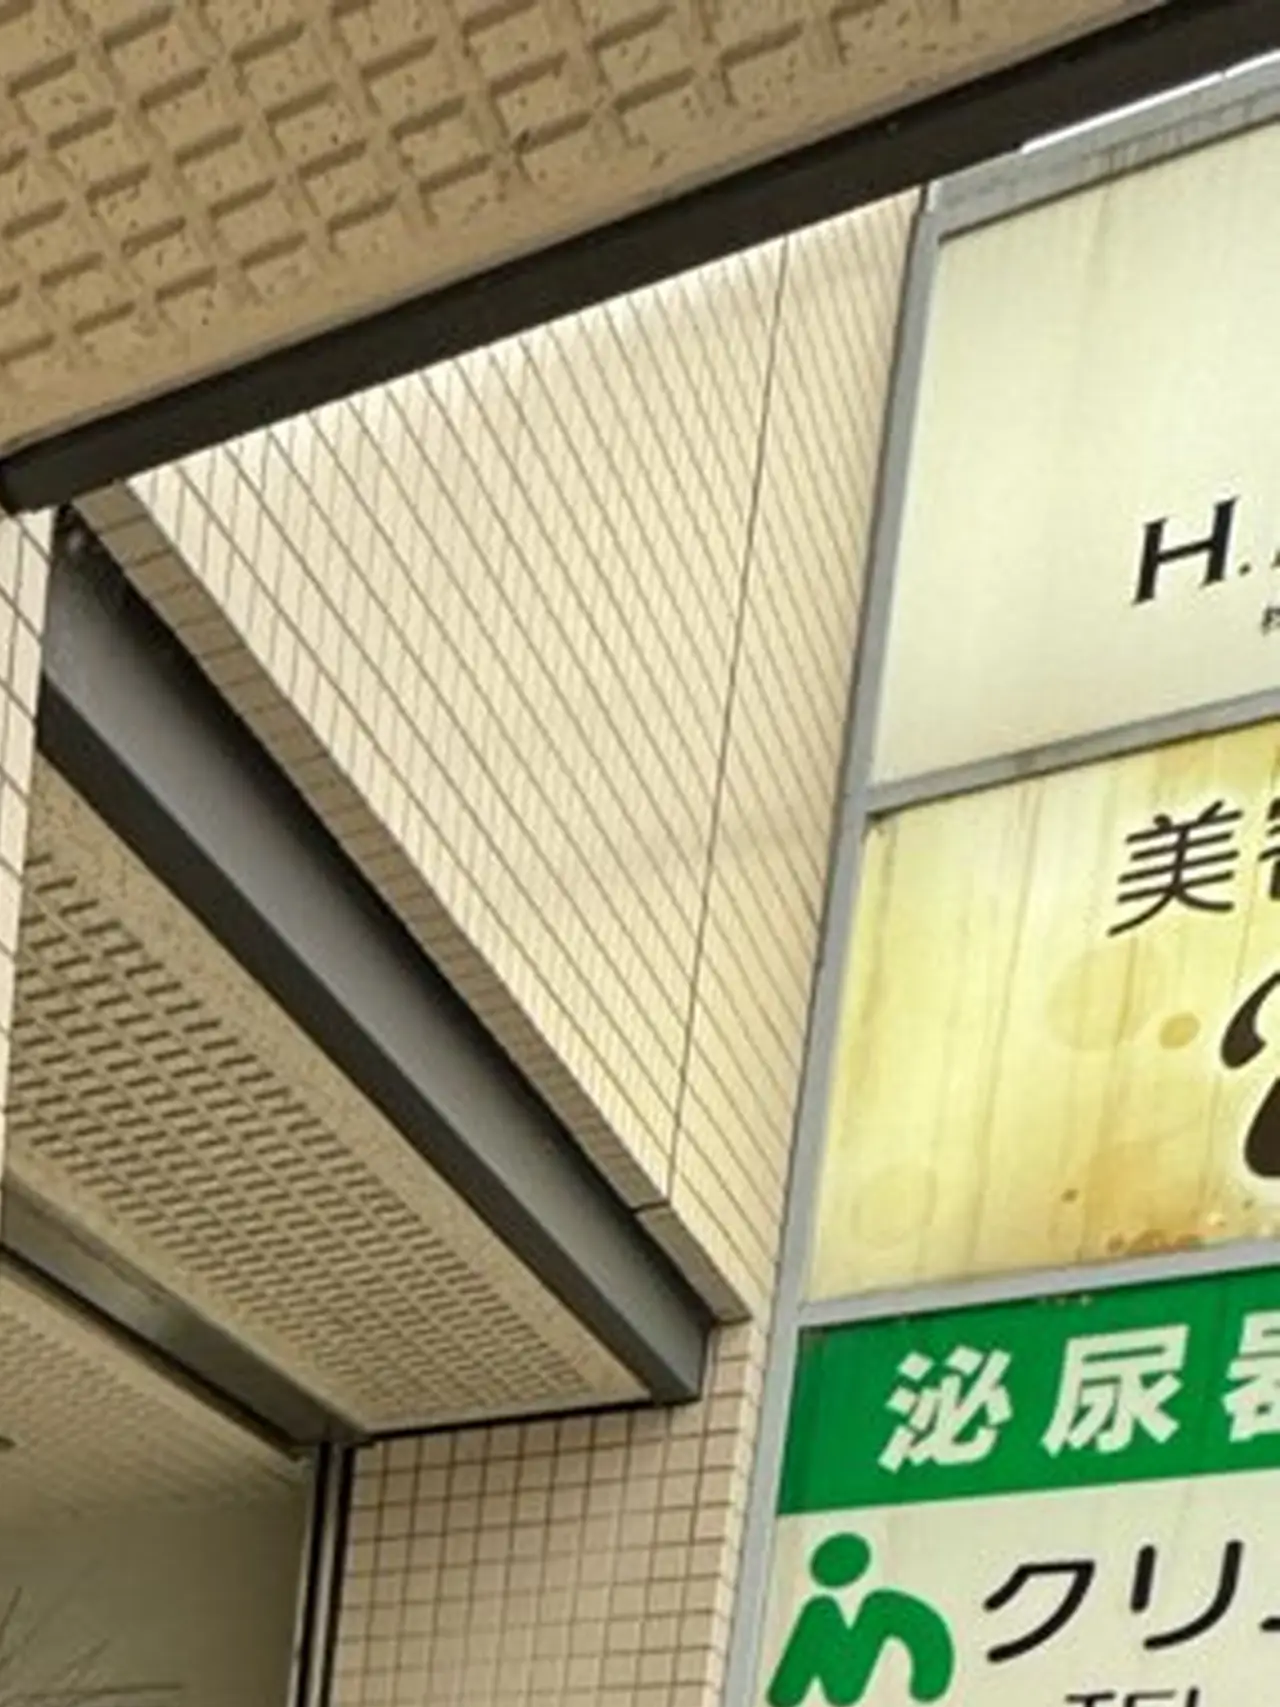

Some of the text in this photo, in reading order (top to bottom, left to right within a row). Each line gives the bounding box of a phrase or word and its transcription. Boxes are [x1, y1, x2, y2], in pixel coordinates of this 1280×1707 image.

[1132, 495, 1280, 605] H.
[1107, 798, 1280, 936] 美
[983, 1539, 1280, 1663] クリ
